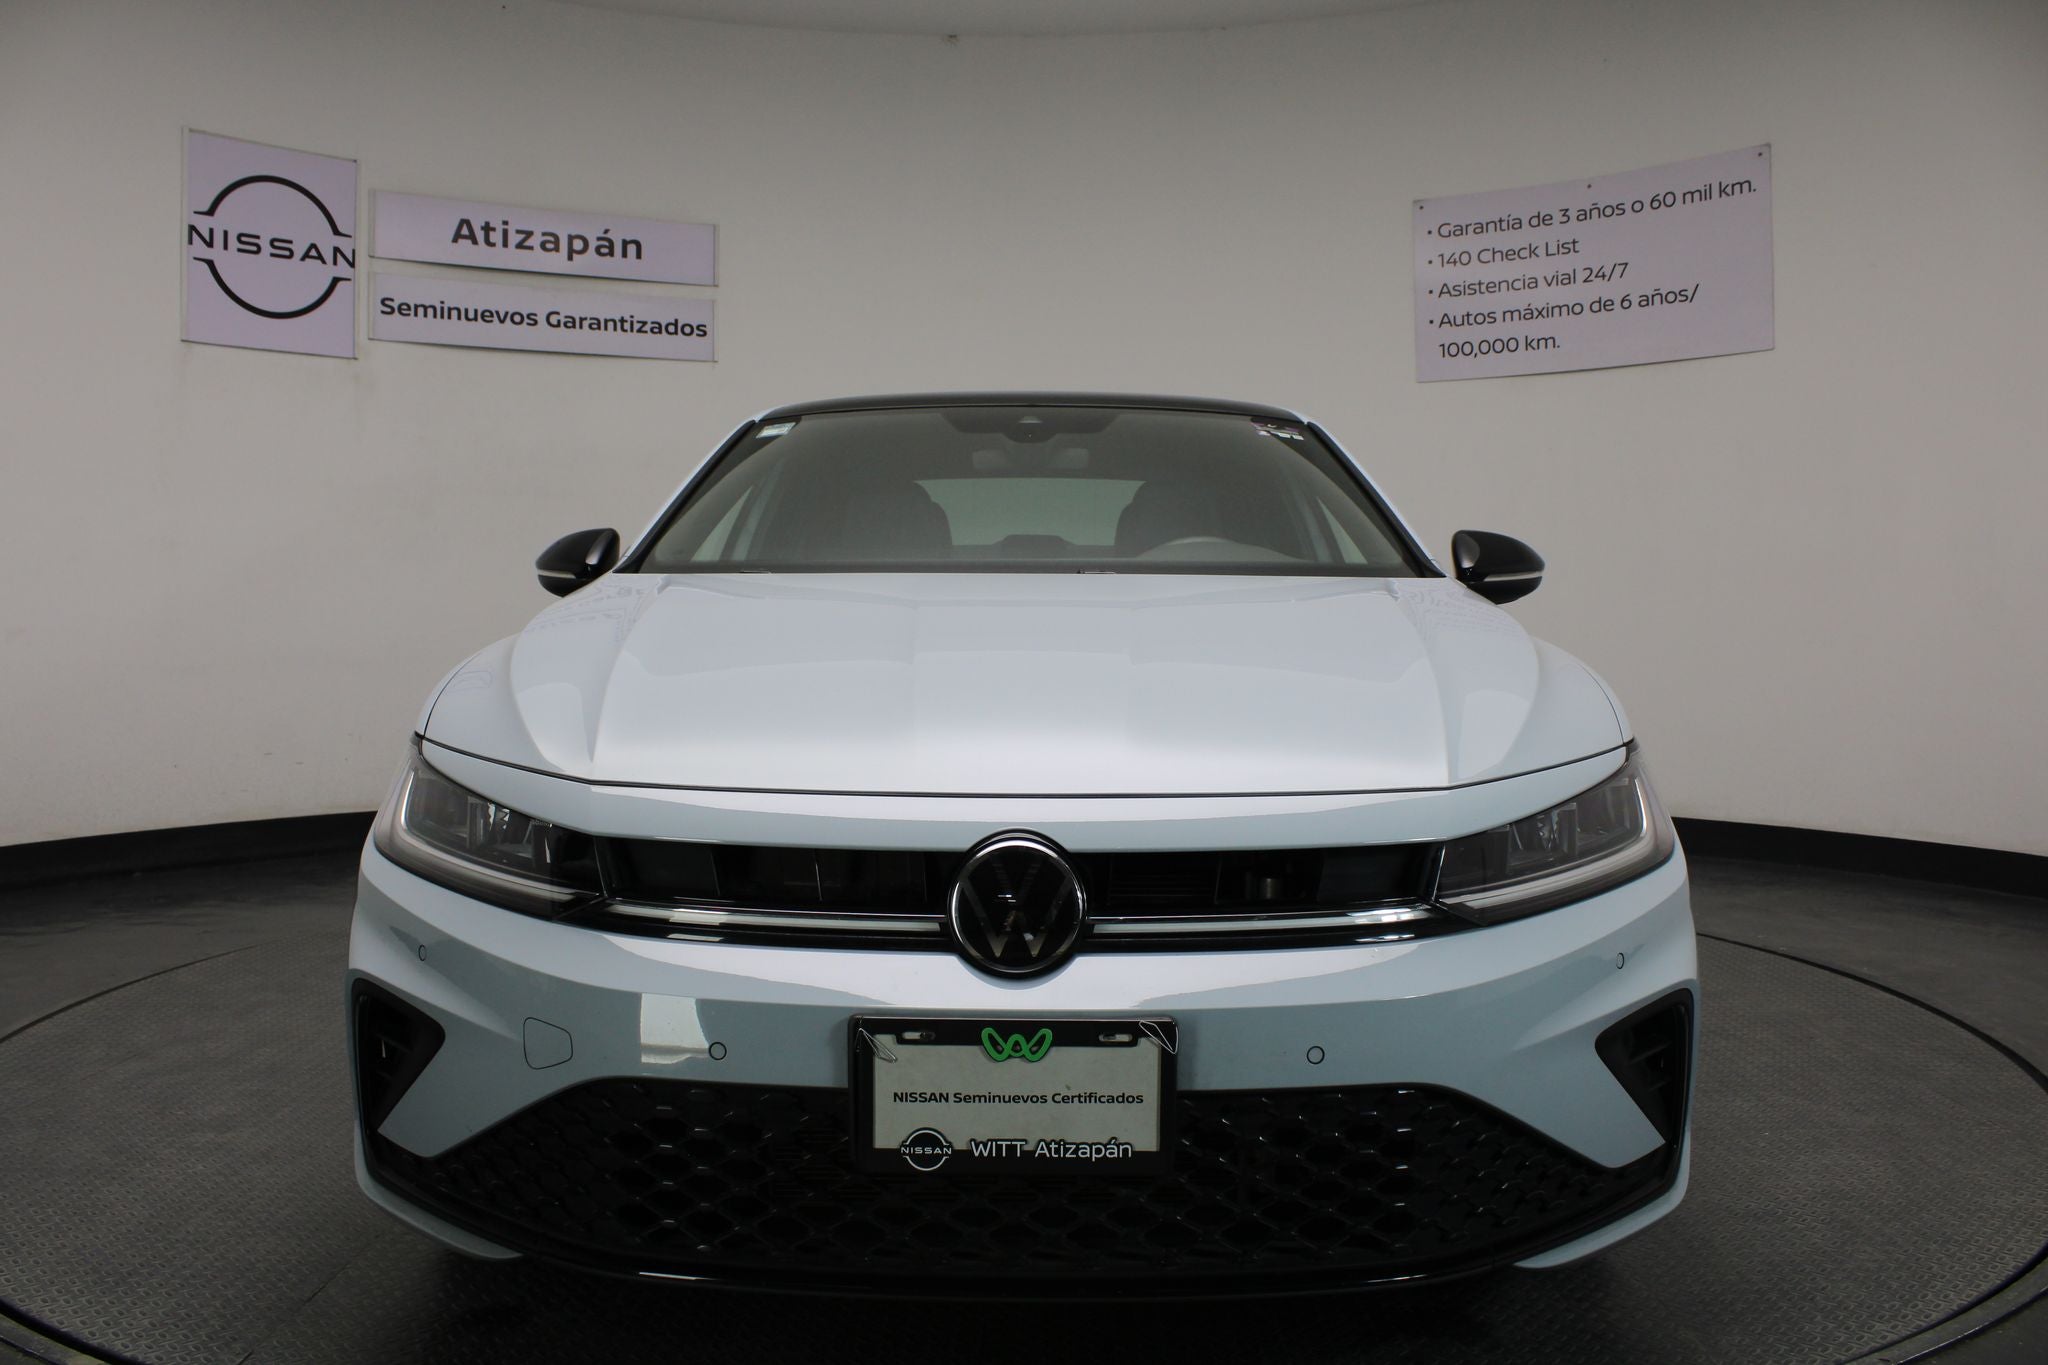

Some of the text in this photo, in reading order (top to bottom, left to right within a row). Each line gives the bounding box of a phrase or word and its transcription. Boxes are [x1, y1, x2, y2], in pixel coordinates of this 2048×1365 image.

[1437, 176, 1757, 240] Garantía de 3 años o 60 mil km.
[187, 223, 356, 269] NISSAN
[450, 217, 645, 262] Atizapán
[1437, 237, 1581, 269] 140 Check List
[1438, 261, 1630, 299] Asistencia vial 24/7
[379, 296, 709, 339] Seminuevos Garantizados
[1438, 283, 1700, 329] Autos máximo de 6 años/
[1438, 333, 1561, 360] 100,000 km.
[893, 1091, 1145, 1105] NISSAN Seminuevos Certificados
[900, 1138, 1133, 1161] NISSAN WITT Atizapán
